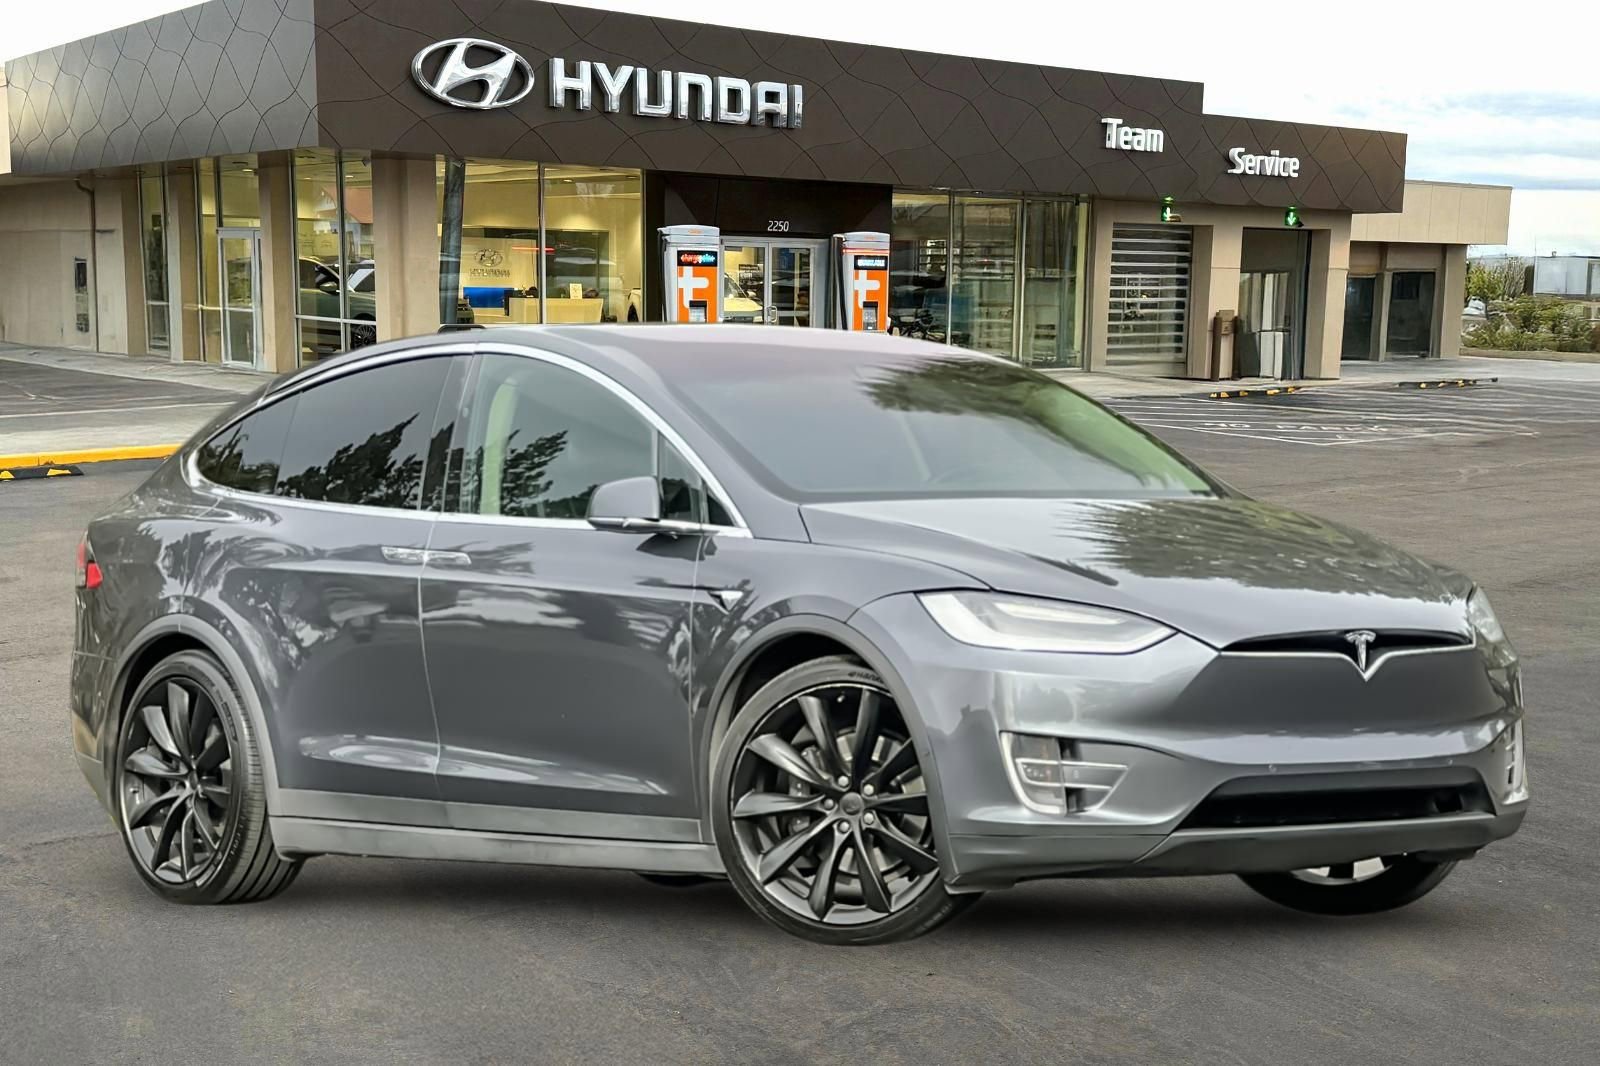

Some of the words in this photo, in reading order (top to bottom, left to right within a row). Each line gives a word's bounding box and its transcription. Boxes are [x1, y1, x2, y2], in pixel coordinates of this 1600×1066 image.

[549, 57, 803, 128] HYUNDAI
[1101, 117, 1164, 152] Team
[1227, 147, 1300, 177] Service
[767, 220, 790, 231] 2250
